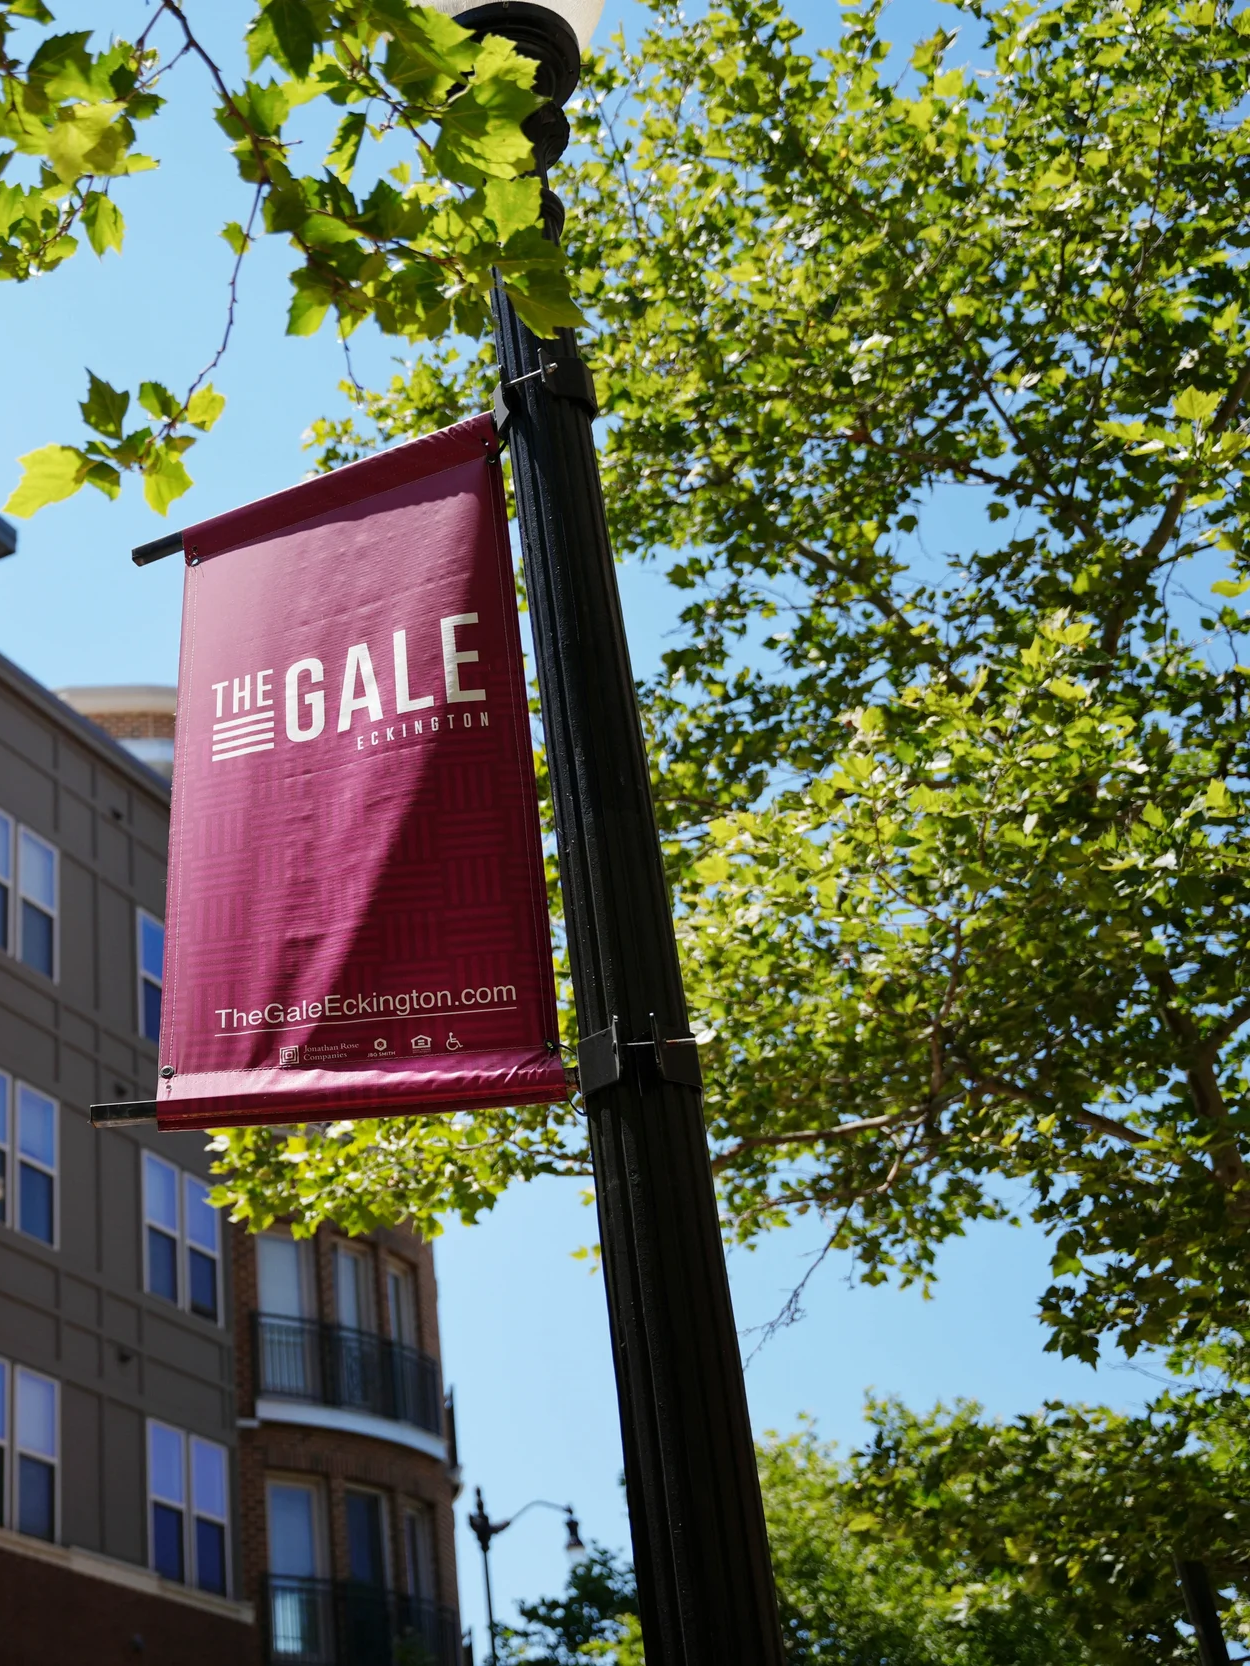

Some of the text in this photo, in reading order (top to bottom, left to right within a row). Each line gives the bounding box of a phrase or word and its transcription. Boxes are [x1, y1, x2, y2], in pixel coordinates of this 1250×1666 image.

[212, 611, 487, 743] THE GALE
[357, 711, 490, 751] ECKINGTON
[215, 983, 517, 1029] TheGaleEckington.com
[303, 1042, 360, 1053] Jonathan Rose
[303, 1051, 348, 1062] Companies
